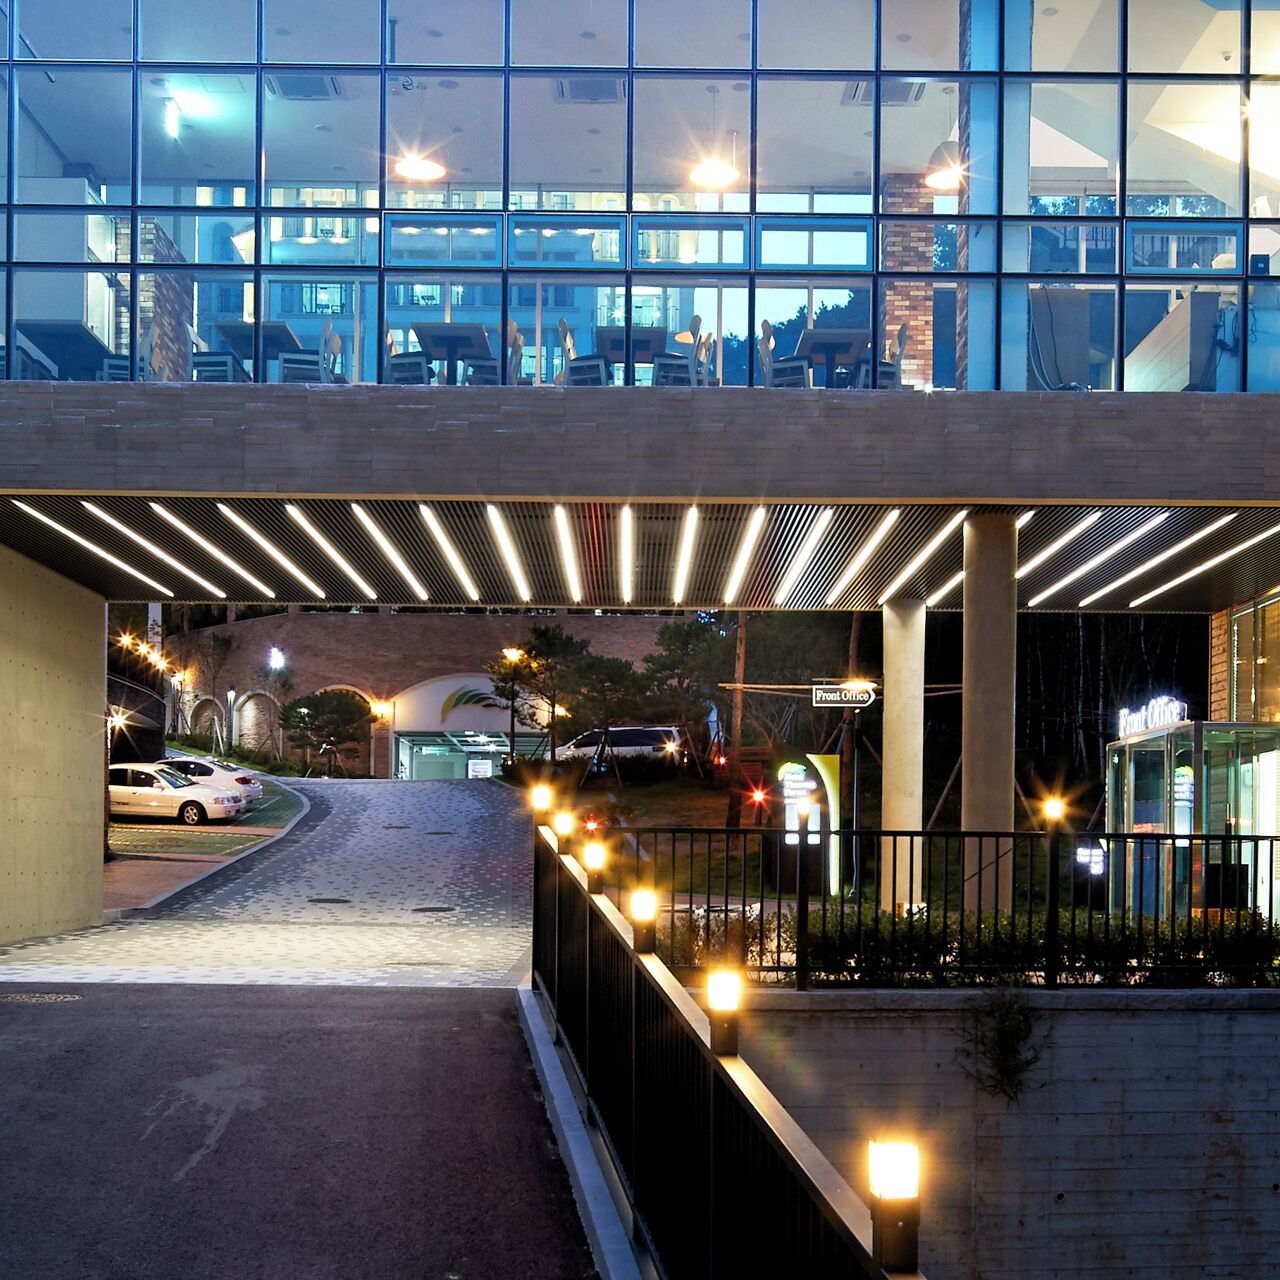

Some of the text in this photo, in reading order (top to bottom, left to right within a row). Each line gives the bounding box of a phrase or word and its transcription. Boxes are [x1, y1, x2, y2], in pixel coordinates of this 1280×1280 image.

[816, 690, 869, 701] Front Office
[1118, 695, 1180, 737] Front Office
